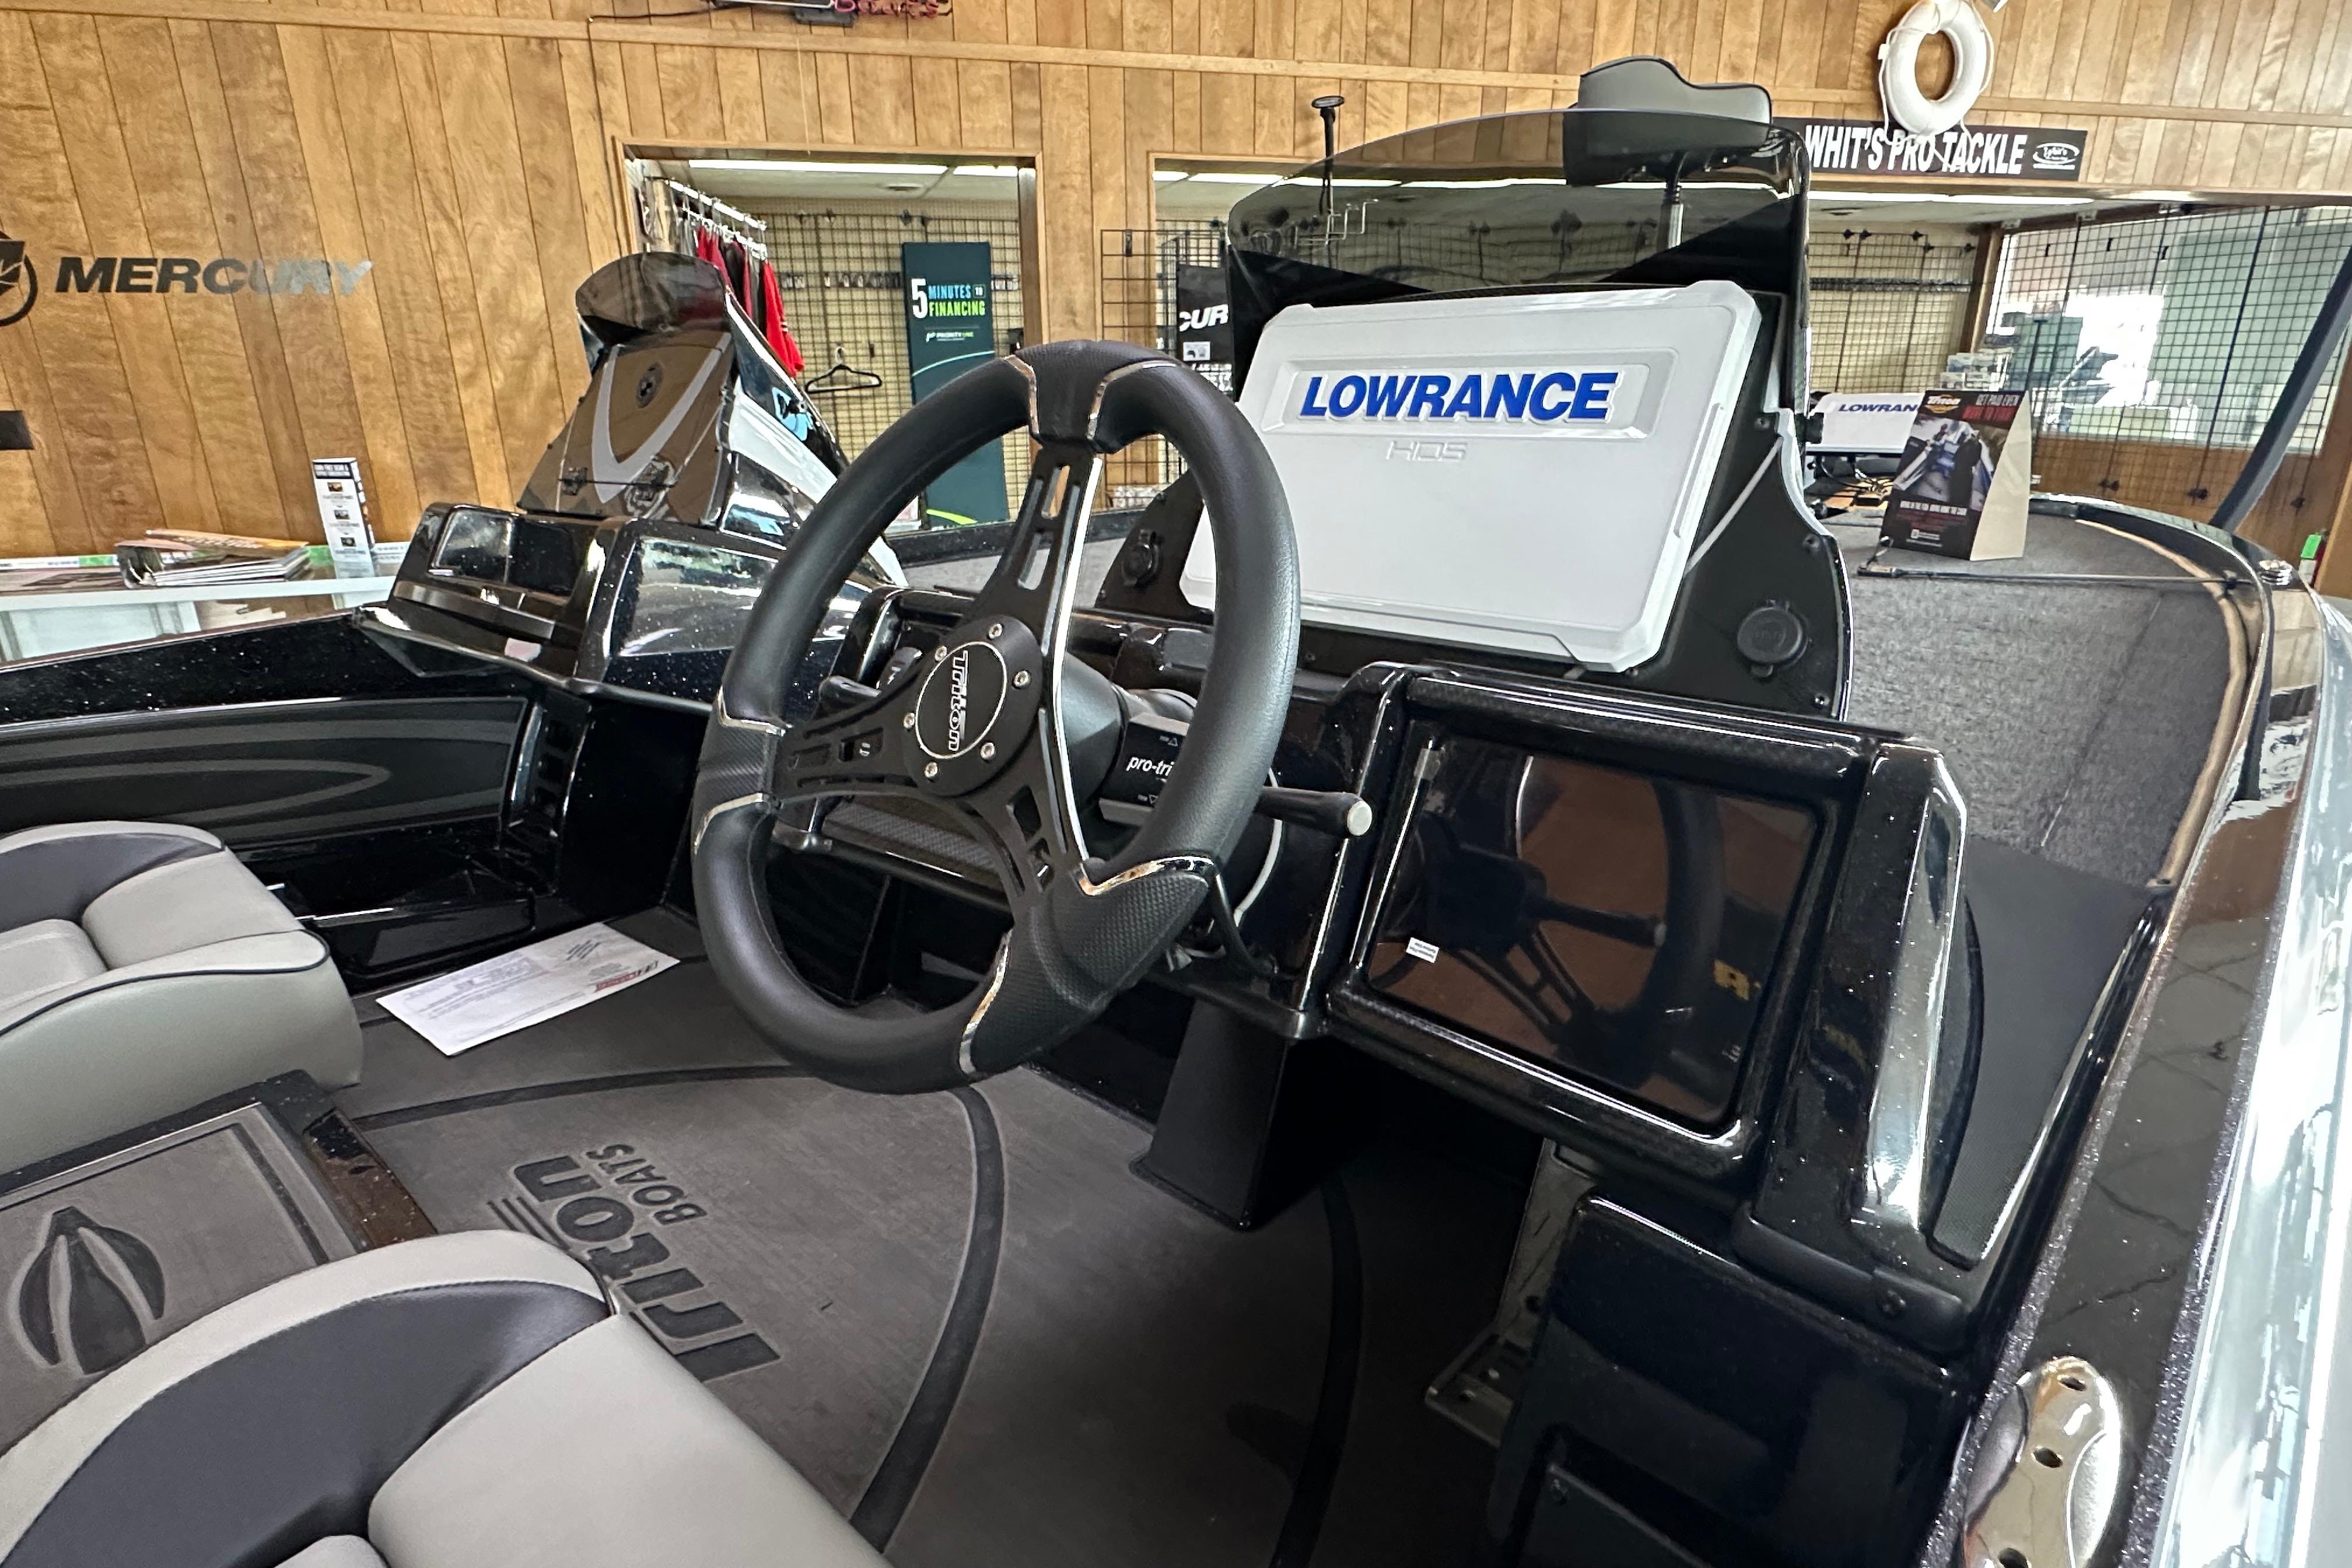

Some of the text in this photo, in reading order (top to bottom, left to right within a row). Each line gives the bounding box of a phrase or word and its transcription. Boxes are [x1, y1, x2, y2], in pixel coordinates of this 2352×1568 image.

[1805, 125, 2028, 175] WHIT'S PRO TACKLE
[55, 257, 373, 295] MERCURY
[911, 278, 928, 318] 5
[928, 284, 971, 299] MINUTES
[929, 300, 986, 317] FINANCING
[1299, 372, 1620, 421] LOWRANCE
[1838, 404, 1919, 412] LOWRAN
[1387, 440, 1468, 463] HDS
[1126, 757, 1175, 776] pro-tri
[587, 1143, 708, 1226] BOATS
